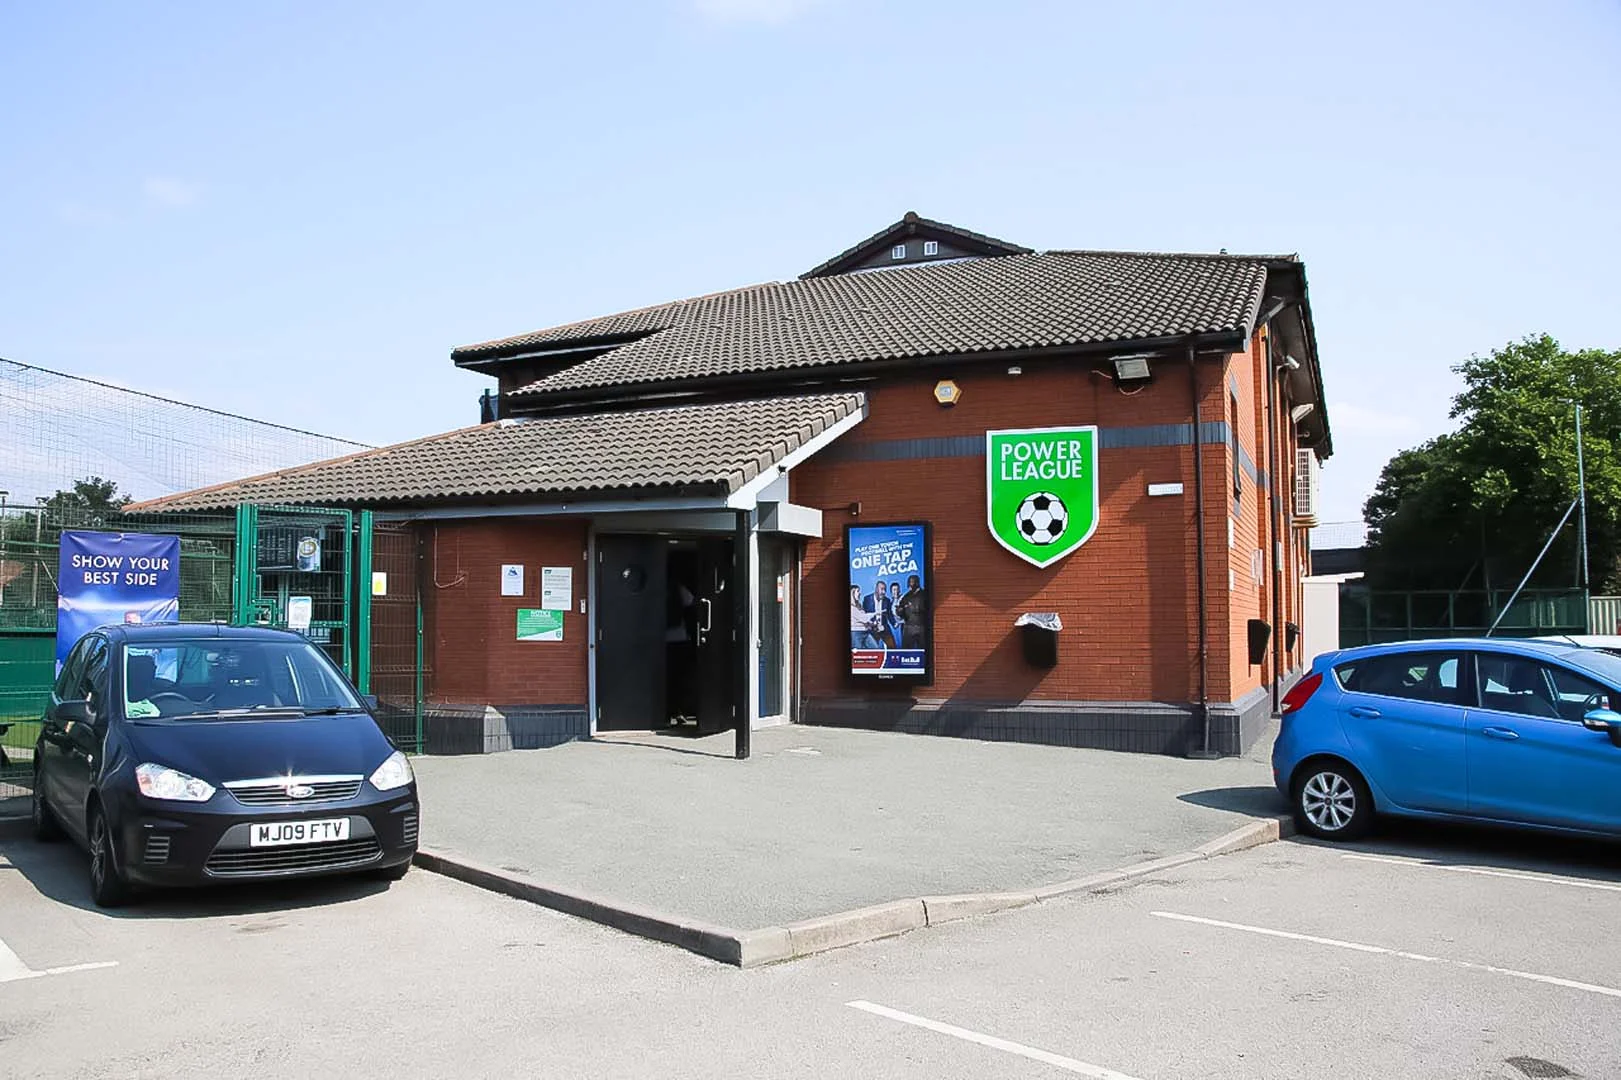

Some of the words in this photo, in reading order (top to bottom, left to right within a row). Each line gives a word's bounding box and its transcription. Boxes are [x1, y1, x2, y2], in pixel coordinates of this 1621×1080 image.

[1001, 440, 1082, 461] POWER
[1001, 460, 1082, 480] LEAGUE
[72, 555, 123, 569] SHOW
[129, 557, 169, 570] YOUR
[851, 554, 881, 569] ONE
[884, 549, 912, 564] TAP
[877, 560, 918, 576] ACCA
[84, 572, 119, 585] BEST
[125, 573, 158, 586] SIDE
[259, 825, 305, 842] MJ09
[310, 822, 343, 839] FTV
